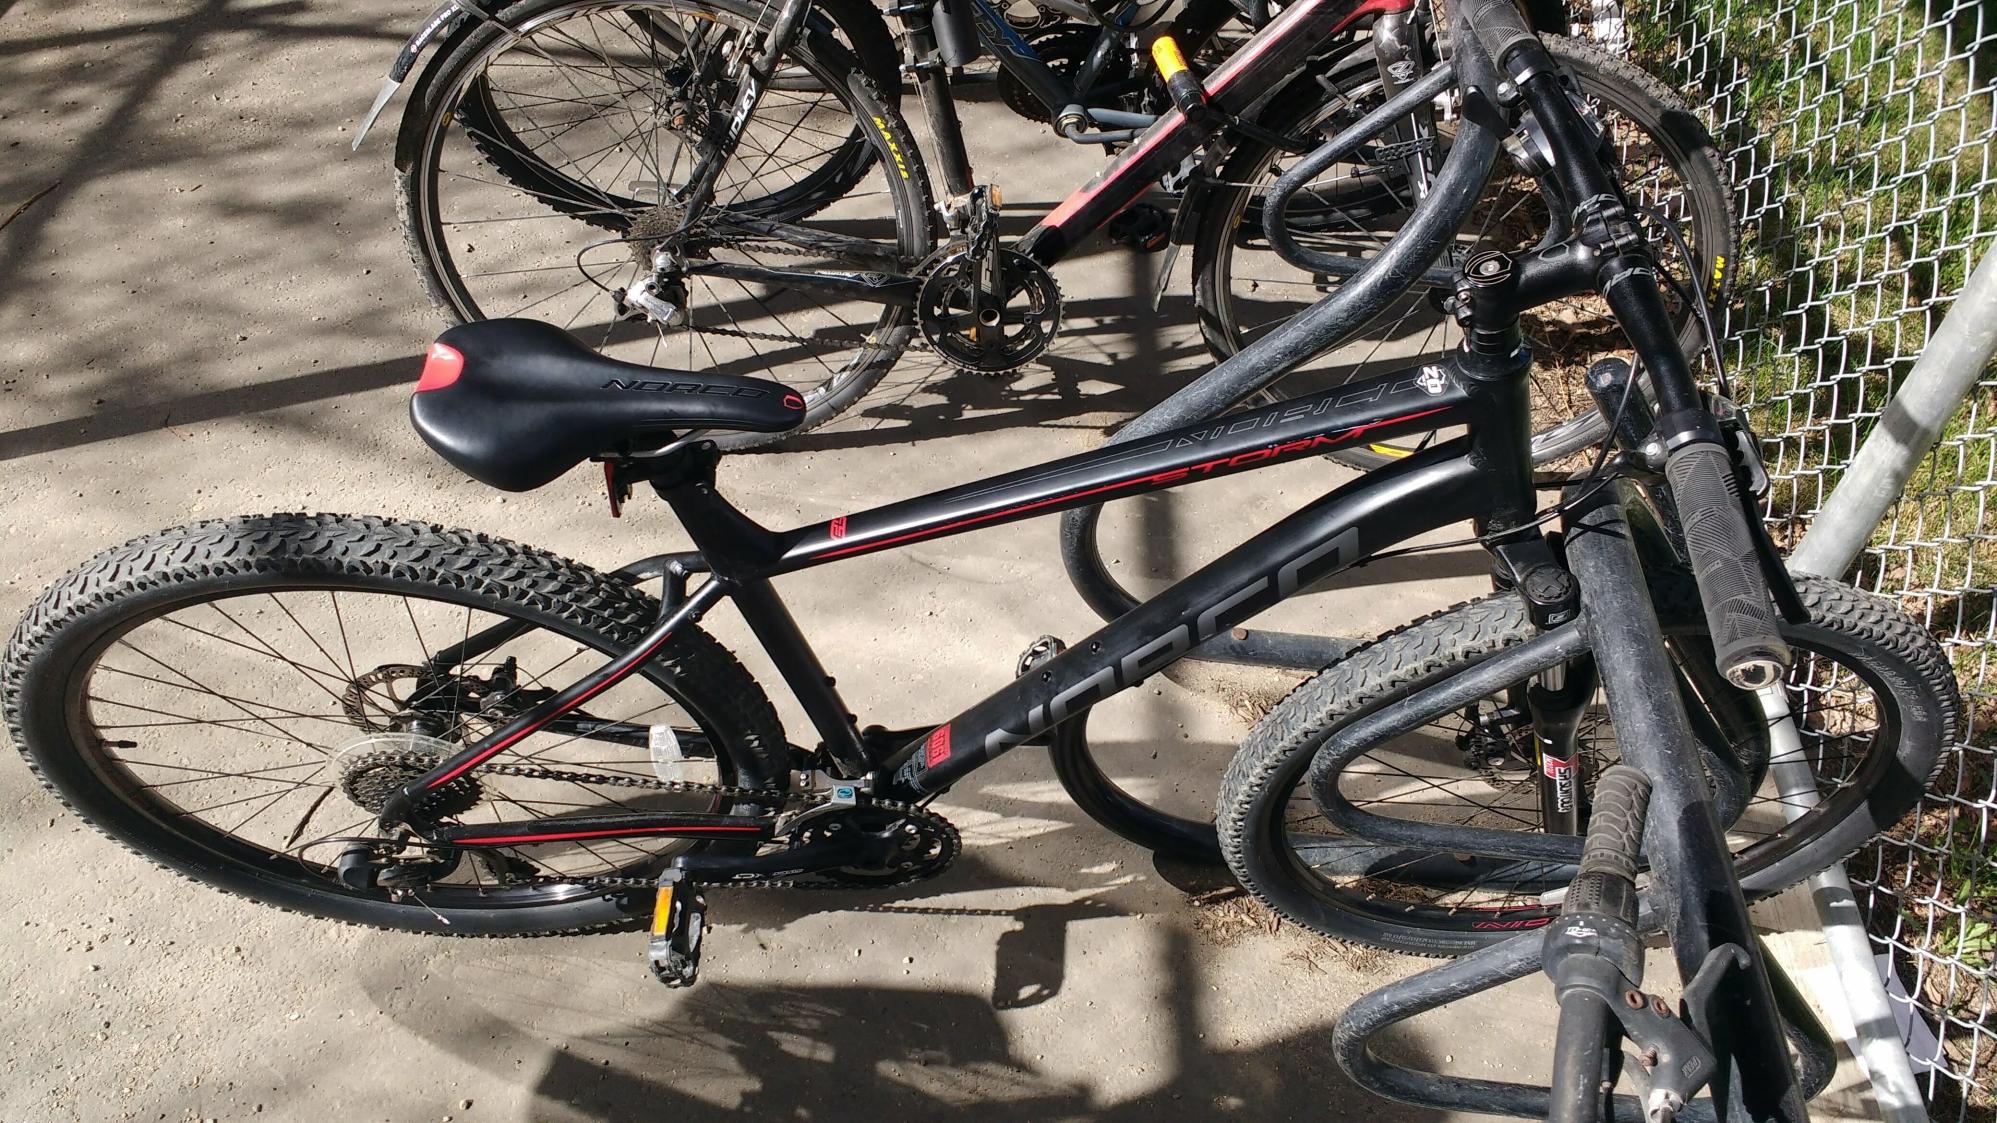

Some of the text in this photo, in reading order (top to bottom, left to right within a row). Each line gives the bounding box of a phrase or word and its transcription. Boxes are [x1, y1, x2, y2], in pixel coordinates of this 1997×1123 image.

[873, 116, 909, 179] MAXXIS
[600, 378, 771, 398] NORCO
[1149, 425, 1372, 486] STORM
